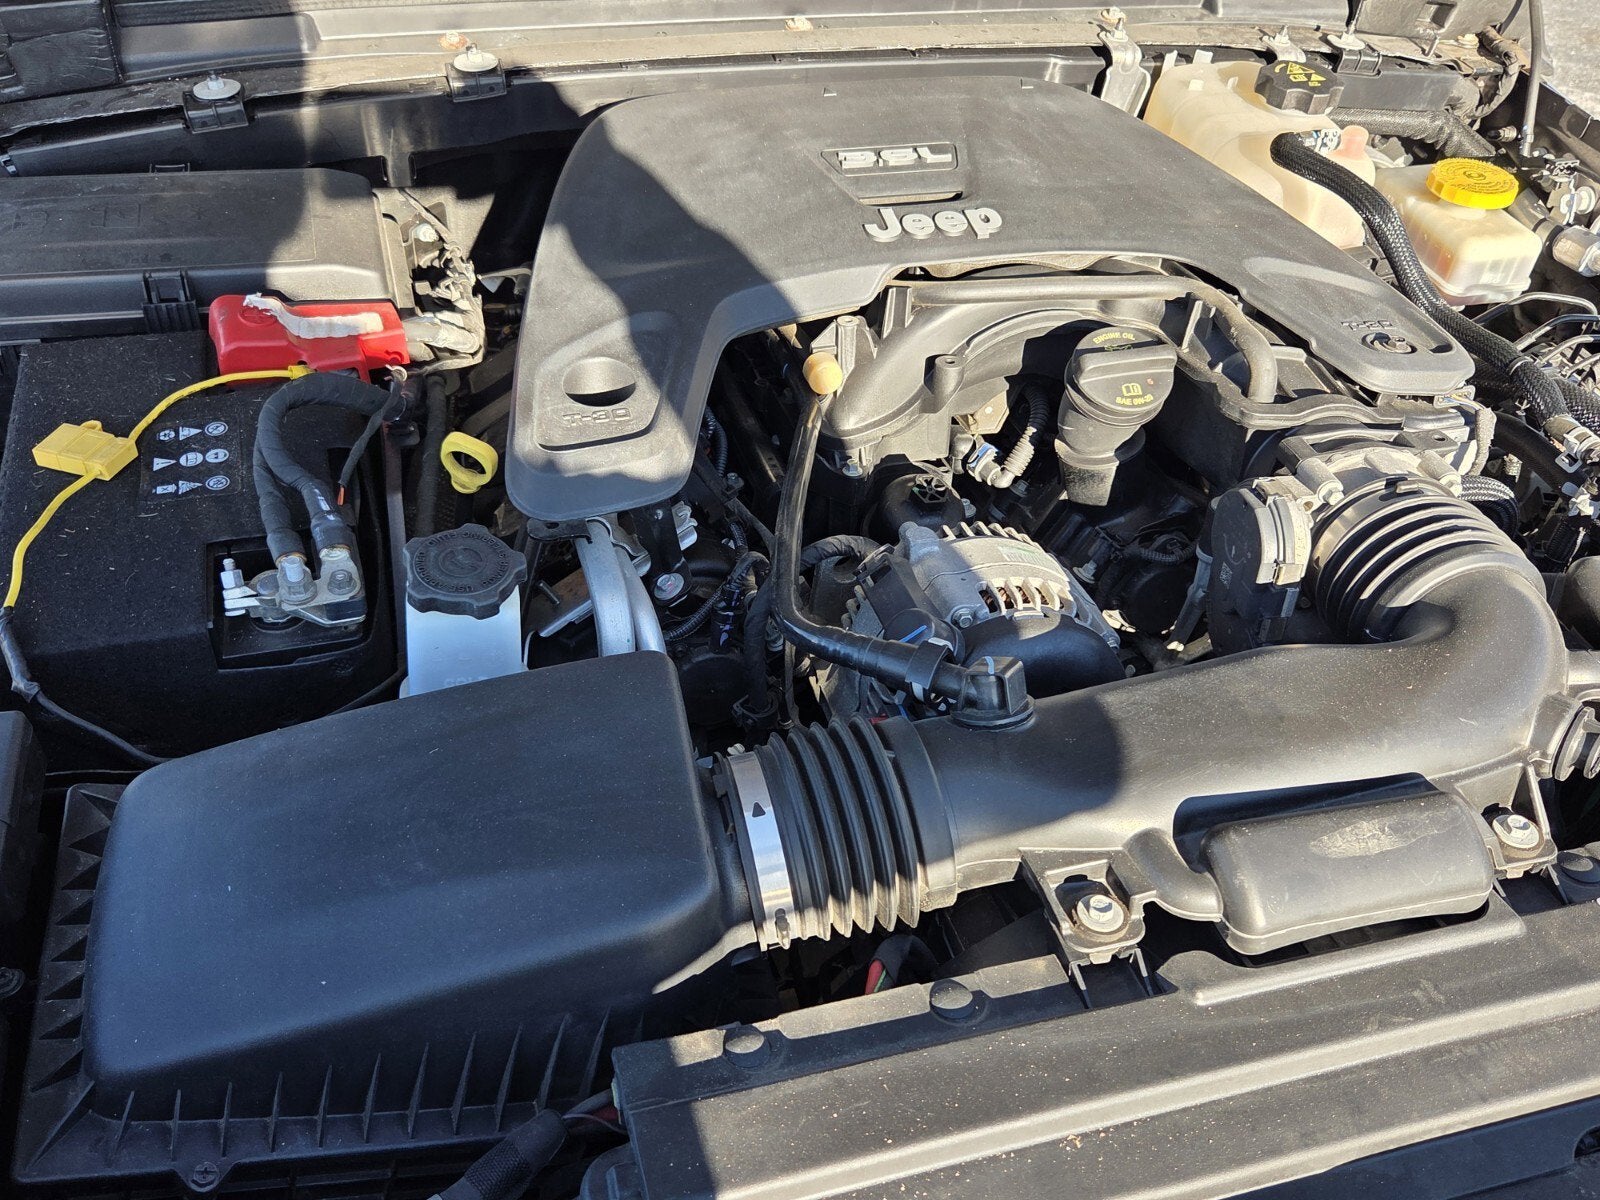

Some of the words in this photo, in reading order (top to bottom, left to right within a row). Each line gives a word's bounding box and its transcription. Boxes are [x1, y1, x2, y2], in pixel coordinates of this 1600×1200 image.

[862, 207, 1002, 242] Jeep
[1093, 333, 1121, 344] ENGINE
[1122, 332, 1136, 341] OIL
[1116, 397, 1132, 405] SAE
